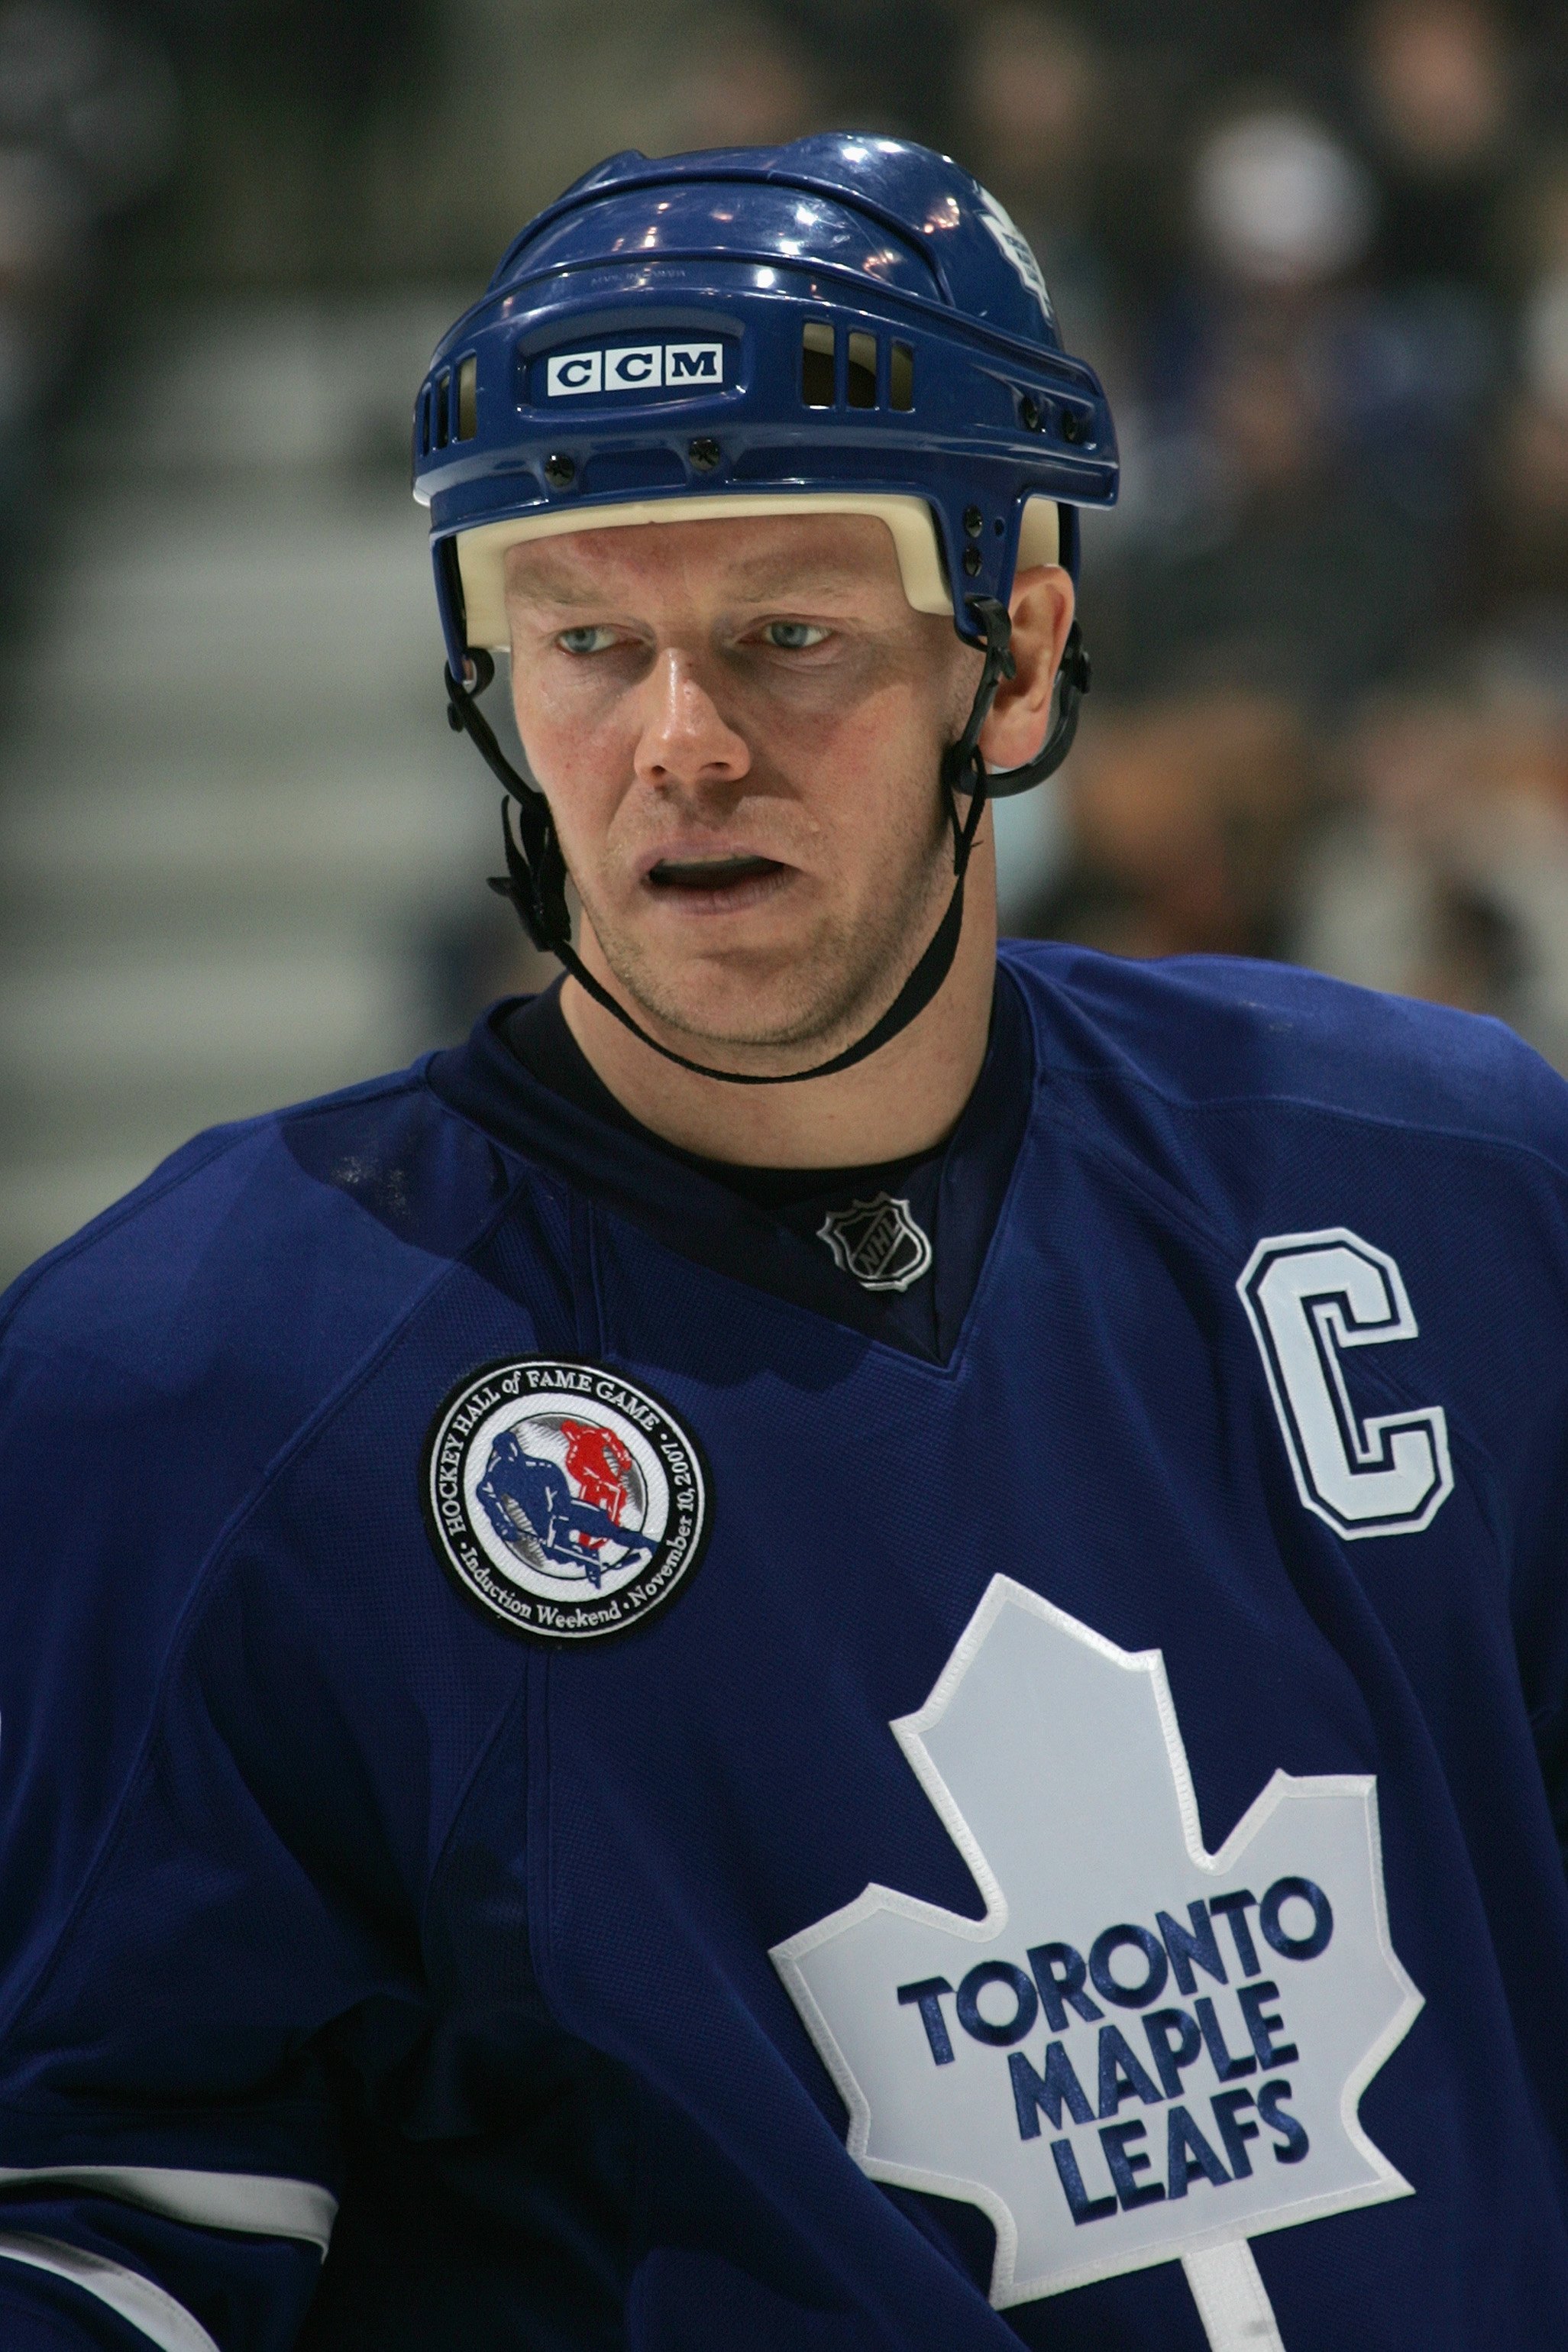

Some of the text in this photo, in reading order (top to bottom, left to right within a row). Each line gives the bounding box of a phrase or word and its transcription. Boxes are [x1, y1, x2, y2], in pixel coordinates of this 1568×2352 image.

[555, 350, 718, 389] CCM
[857, 1216, 904, 1277] NHL
[438, 1369, 661, 1537] HOCKEY HALL of FAME GAME
[1236, 1227, 1454, 1542] C
[460, 1546, 622, 1629] Induction Weekend
[627, 1515, 693, 1608] November
[660, 1442, 693, 1486] 2007
[897, 1875, 1334, 2066] TORONTO
[1007, 1980, 1300, 2141] MAPLE
[1049, 2079, 1310, 2227] LEAFS
